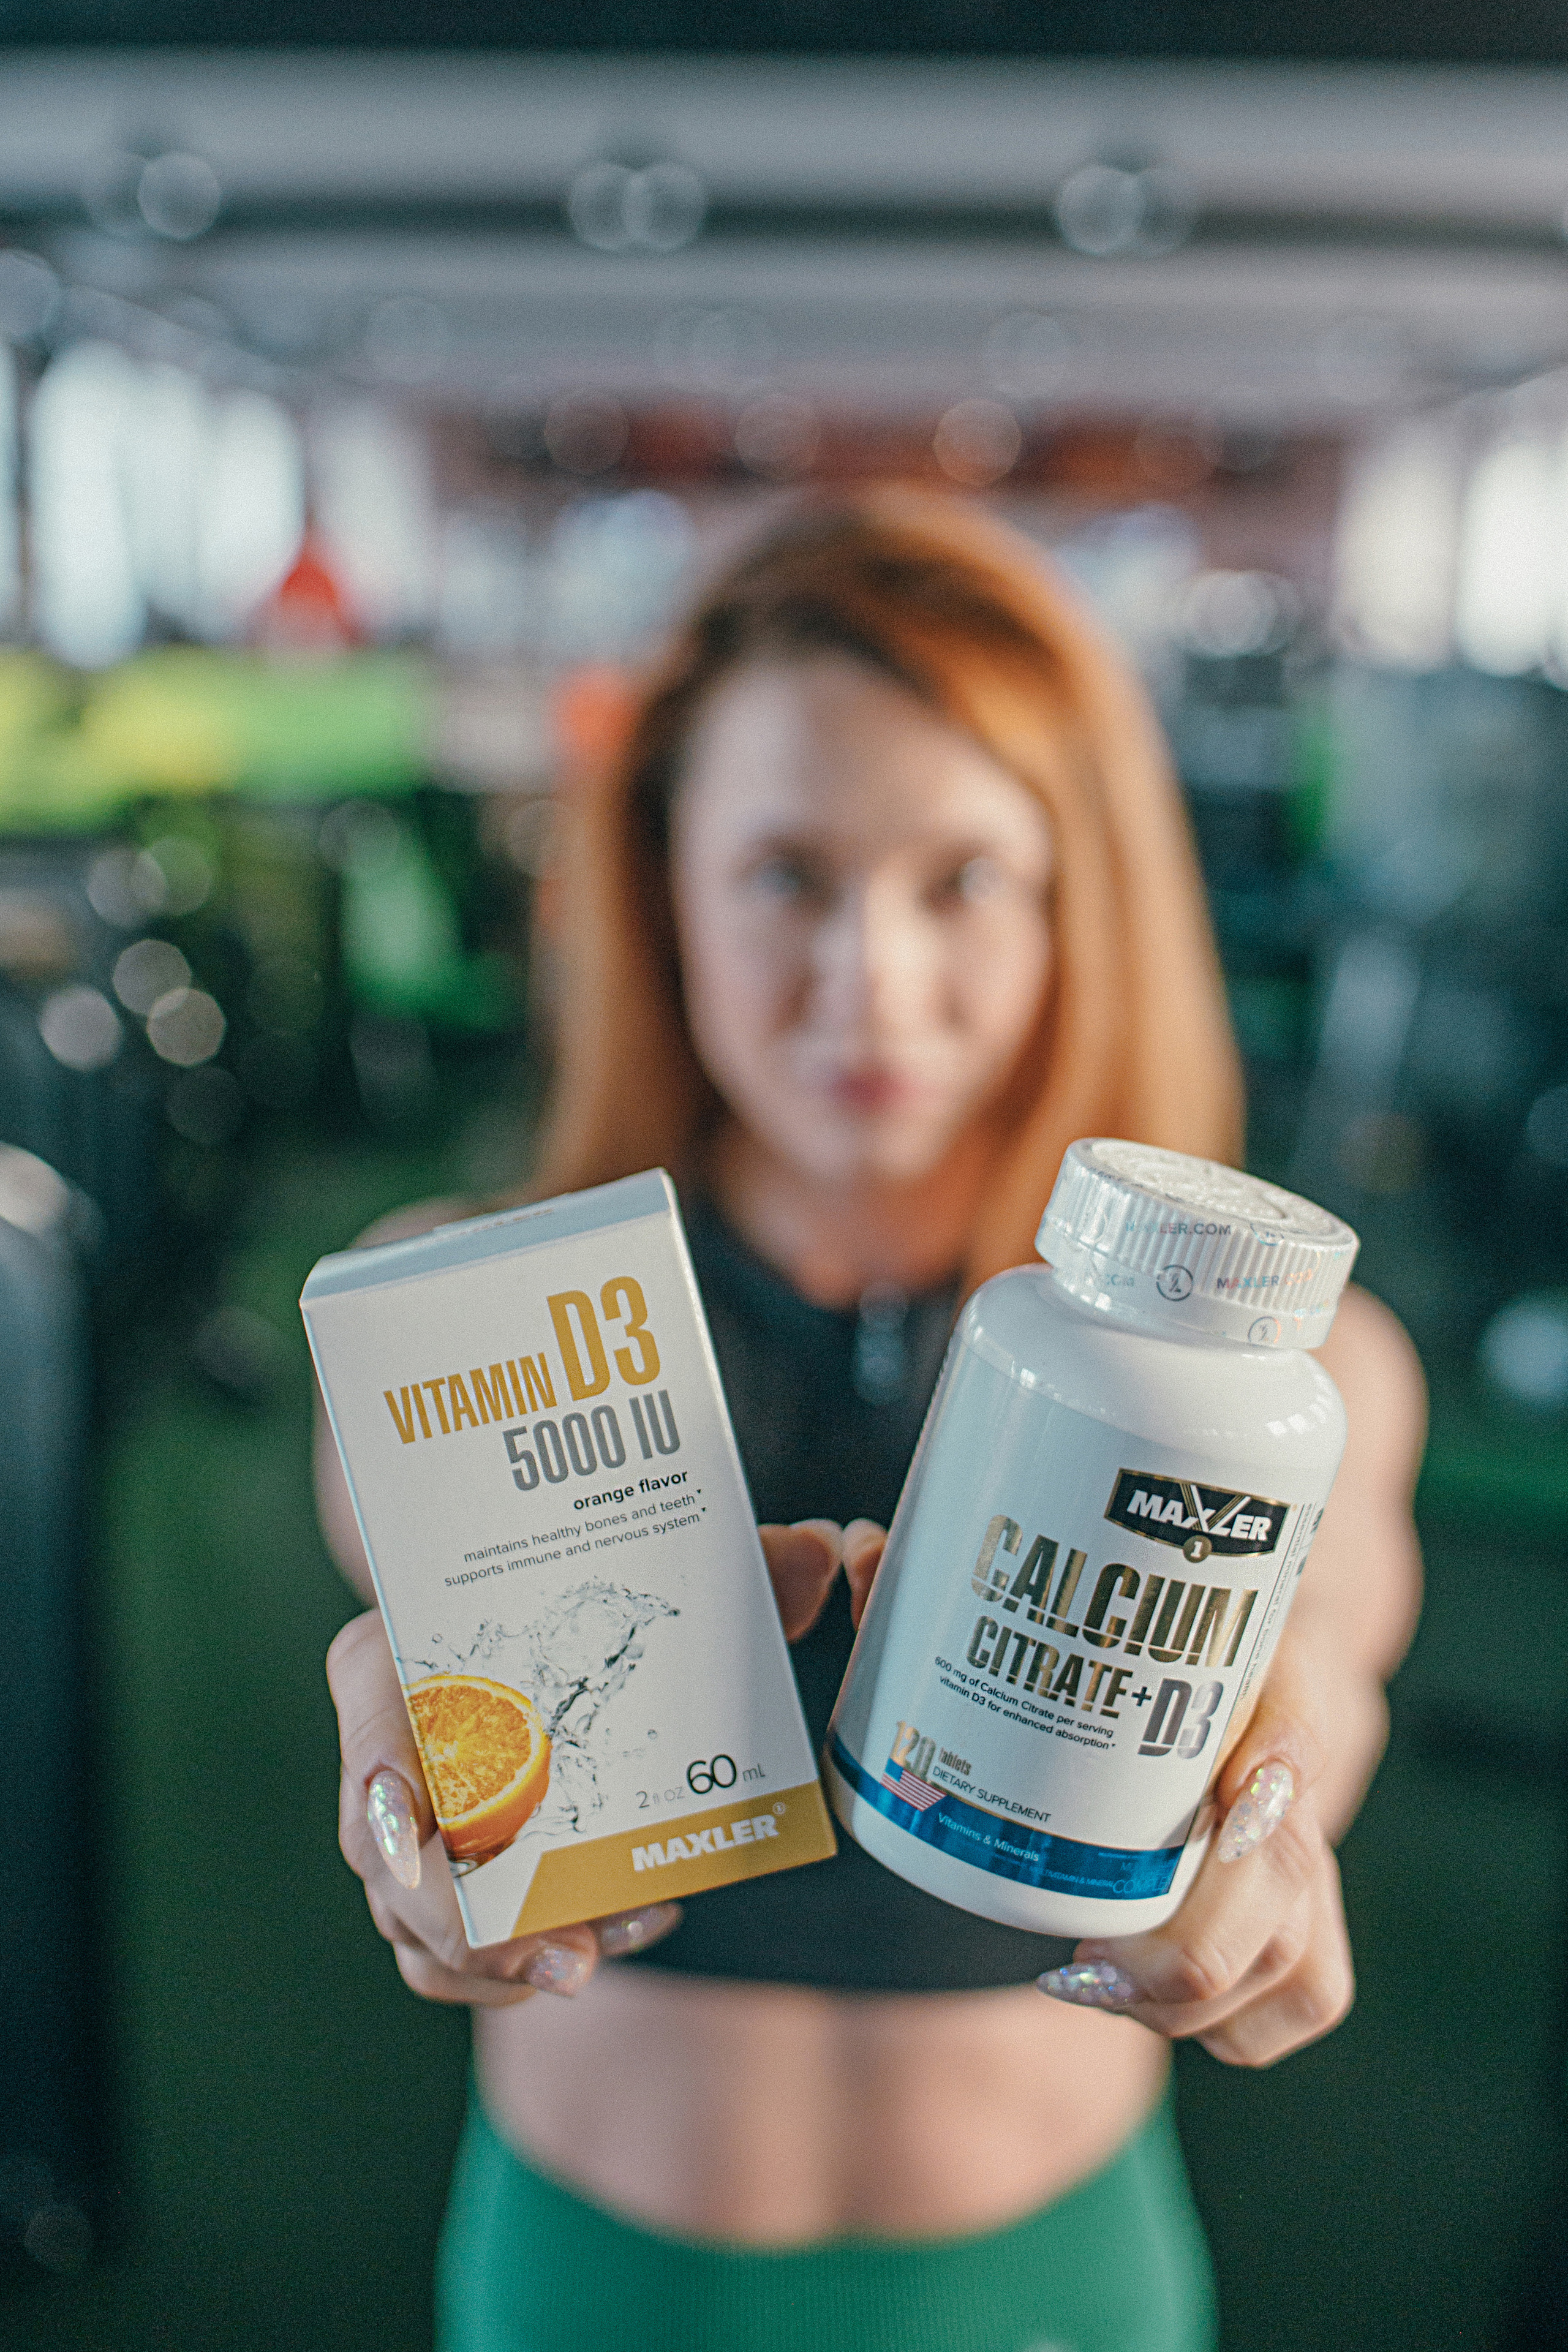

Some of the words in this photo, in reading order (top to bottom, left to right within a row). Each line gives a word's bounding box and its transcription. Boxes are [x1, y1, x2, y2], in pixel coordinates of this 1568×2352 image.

[1125, 1222, 1232, 1235] MLER.COM
[383, 1352, 557, 1444] VITAMIN
[546, 1276, 661, 1401] D3
[502, 1404, 627, 1491] 5000
[628, 1389, 680, 1460] IU
[574, 1486, 634, 1510] orange
[639, 1471, 688, 1493] flavor
[1126, 1484, 1272, 1542] MAXLER
[445, 1564, 504, 1586] supports
[507, 1550, 562, 1571] immune
[566, 1541, 590, 1556] and
[595, 1527, 649, 1548] nervous
[464, 1539, 529, 1562] maintains
[531, 1525, 581, 1545] healthy
[584, 1513, 627, 1532] bones
[631, 1504, 657, 1520] and
[1191, 1540, 1203, 1558] 1
[971, 1514, 1259, 1667] CALCIUM
[966, 1615, 1133, 1719] CITRATE
[935, 1656, 952, 1672] 600
[953, 1668, 967, 1683] mg
[969, 1678, 981, 1687] of
[981, 1682, 1019, 1706] Calcium
[1021, 1700, 1055, 1719] Citrate
[1056, 1715, 1075, 1726] per
[1077, 1721, 1114, 1738] serving
[940, 1675, 970, 1698] vitamin
[971, 1692, 986, 1705] D3
[987, 1700, 1002, 1713] for
[1003, 1708, 1054, 1733] enhanced
[889, 1720, 937, 1781] 120
[938, 1746, 973, 1776] tablets
[635, 1790, 650, 1809] 2
[686, 1753, 737, 1795] 60
[932, 1766, 976, 1793] DIETARY
[977, 1789, 1052, 1823] SUPPLEMENT
[938, 1812, 982, 1841] Vitamins
[982, 1835, 991, 1845] &
[993, 1838, 1040, 1862] Minerals
